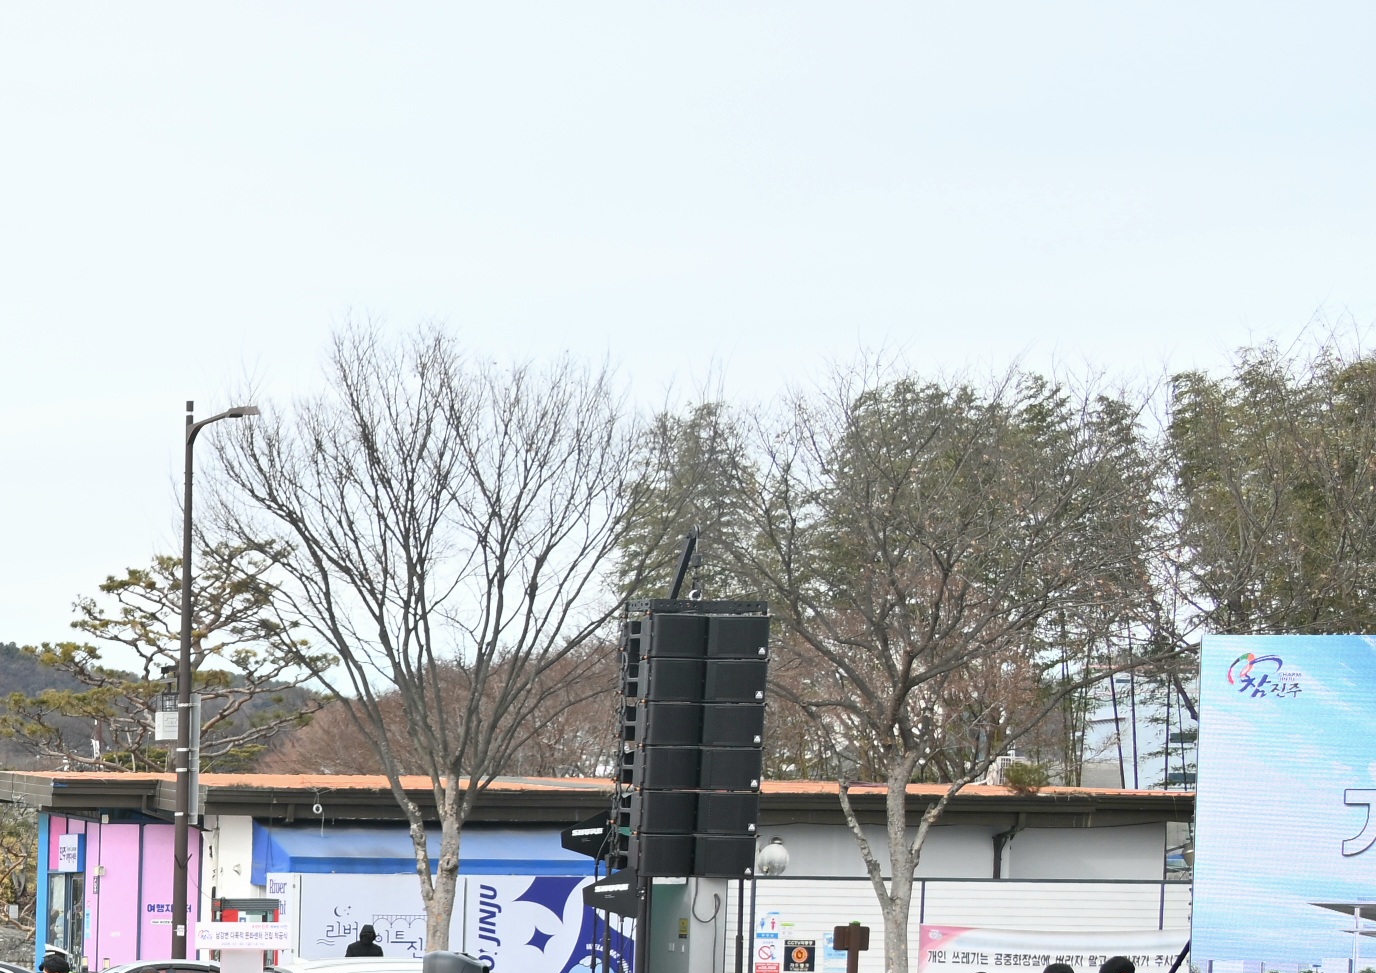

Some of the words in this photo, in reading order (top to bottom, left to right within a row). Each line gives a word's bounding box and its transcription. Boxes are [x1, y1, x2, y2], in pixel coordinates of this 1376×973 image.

[572, 828, 604, 836] SHURE
[269, 879, 287, 894] River
[594, 884, 630, 892] SHURE
[478, 884, 502, 946] JINJU
[928, 950, 946, 963] 개인
[952, 952, 988, 965] 쓰레기는
[994, 953, 1050, 966] 공중화장실에
[1056, 954, 1083, 967] 버리지
